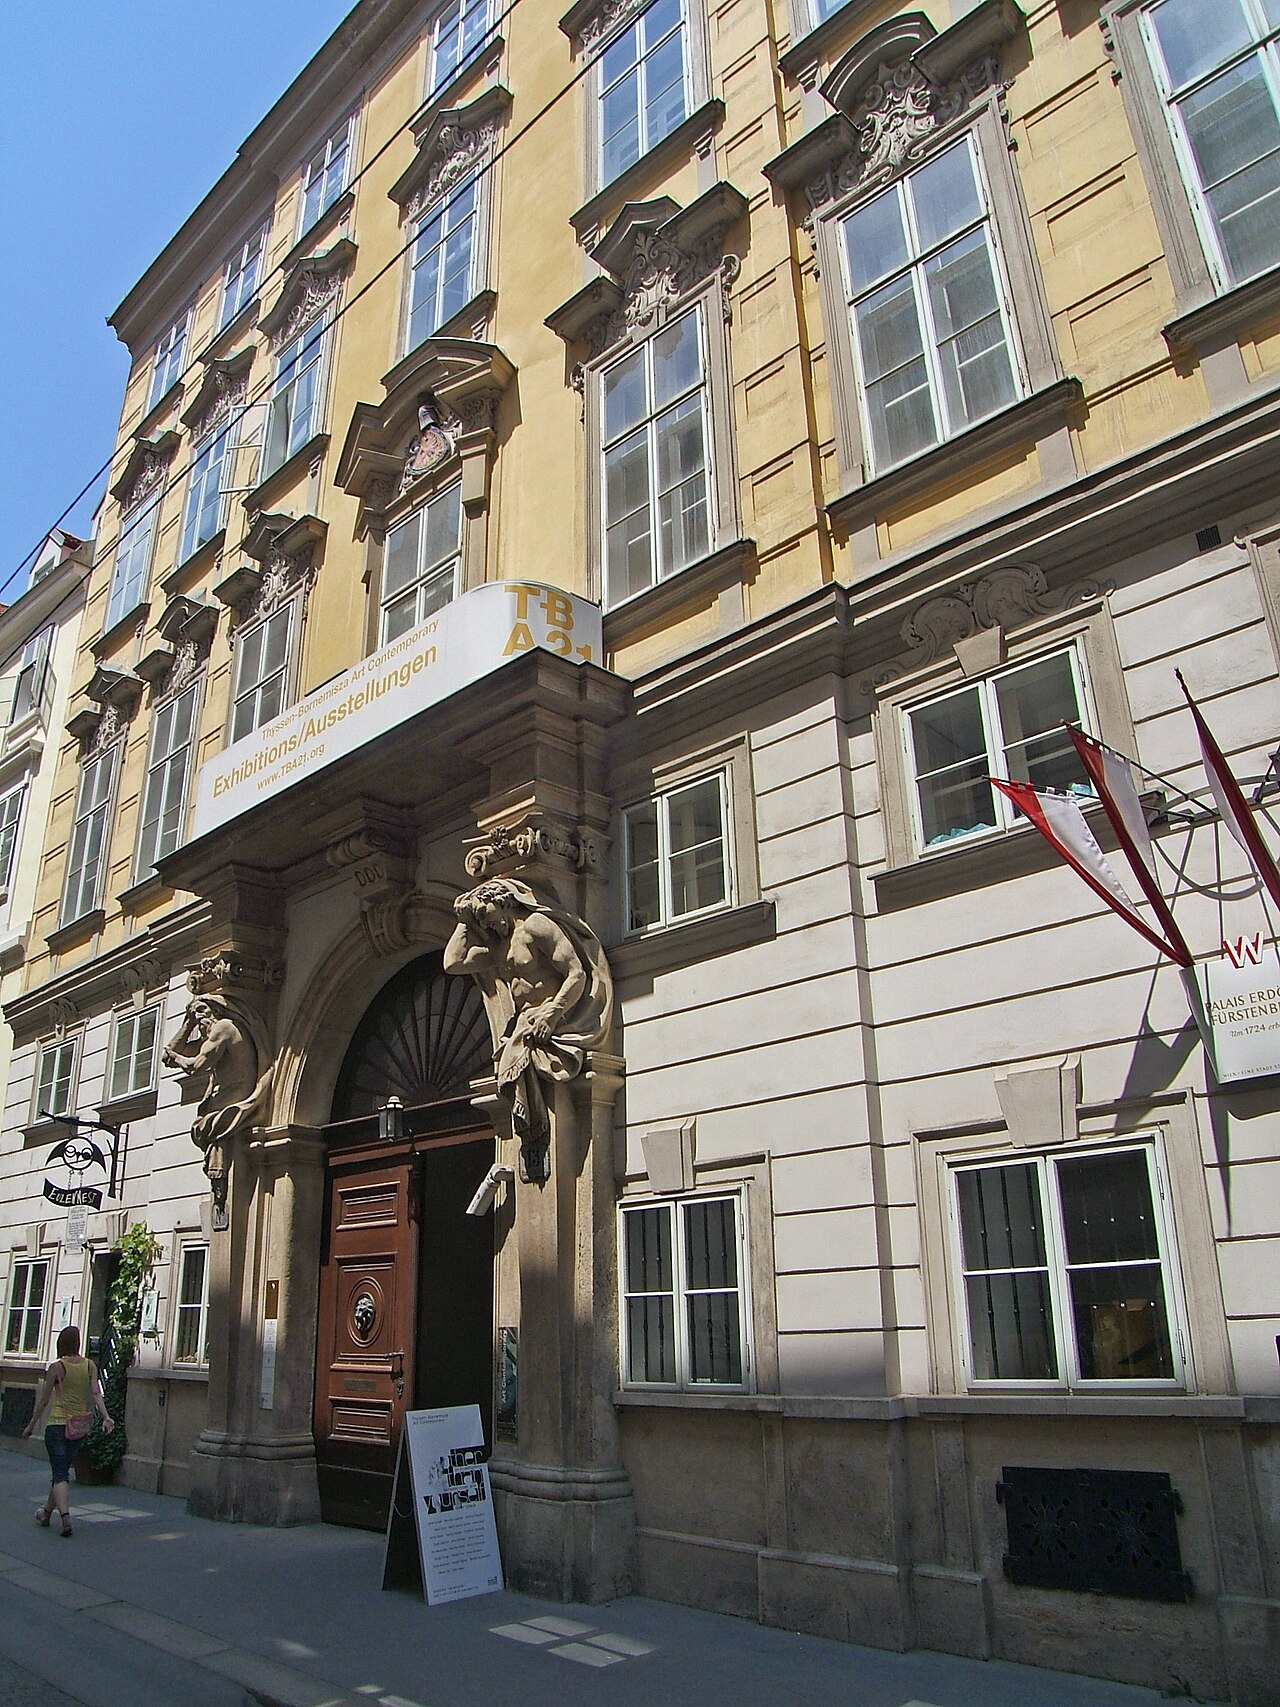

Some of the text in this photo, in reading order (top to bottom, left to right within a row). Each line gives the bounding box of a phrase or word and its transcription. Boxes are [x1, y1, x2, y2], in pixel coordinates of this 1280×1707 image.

[262, 619, 439, 740] Thyssen-Bornemisza Art Contemporary
[213, 645, 437, 798] Exhibitions/Ausstellungen
[256, 744, 325, 790] www.TBA21.org
[1222, 931, 1263, 969] W
[1205, 995, 1245, 1013] PALAIS
[1244, 1024, 1266, 1035] 1724
